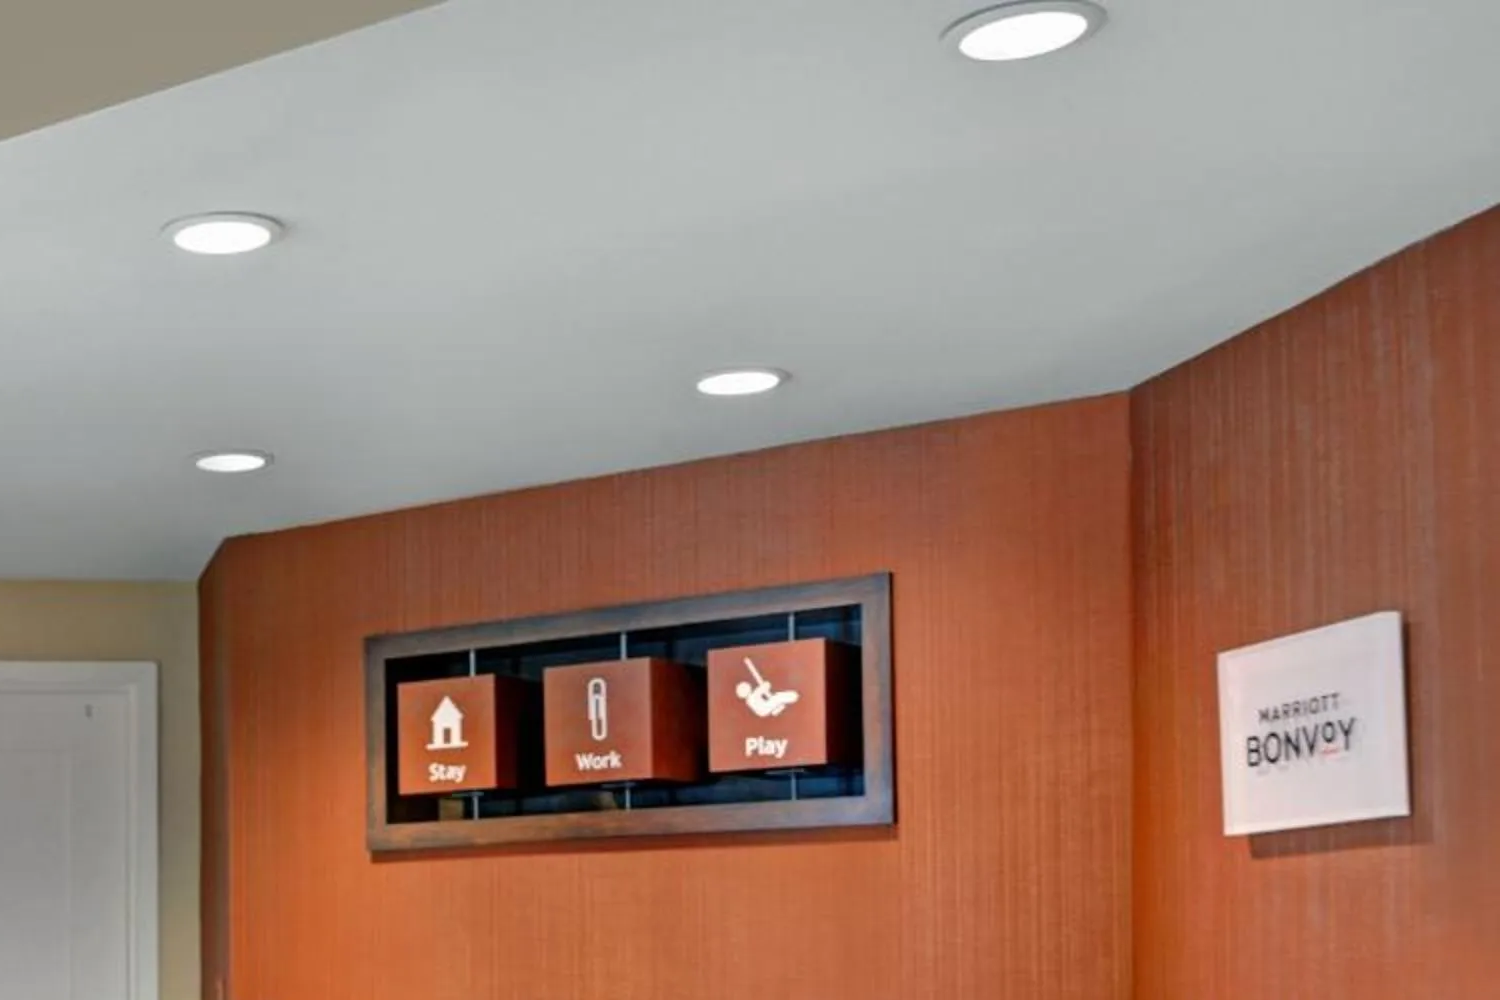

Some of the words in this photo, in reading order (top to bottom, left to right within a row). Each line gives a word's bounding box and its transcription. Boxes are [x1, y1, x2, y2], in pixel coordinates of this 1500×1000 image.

[1258, 693, 1340, 723] MARRIOTT
[745, 736, 789, 759] Play
[1246, 718, 1356, 767] BONVOY
[575, 750, 622, 771] Work
[428, 762, 467, 783] Stay
